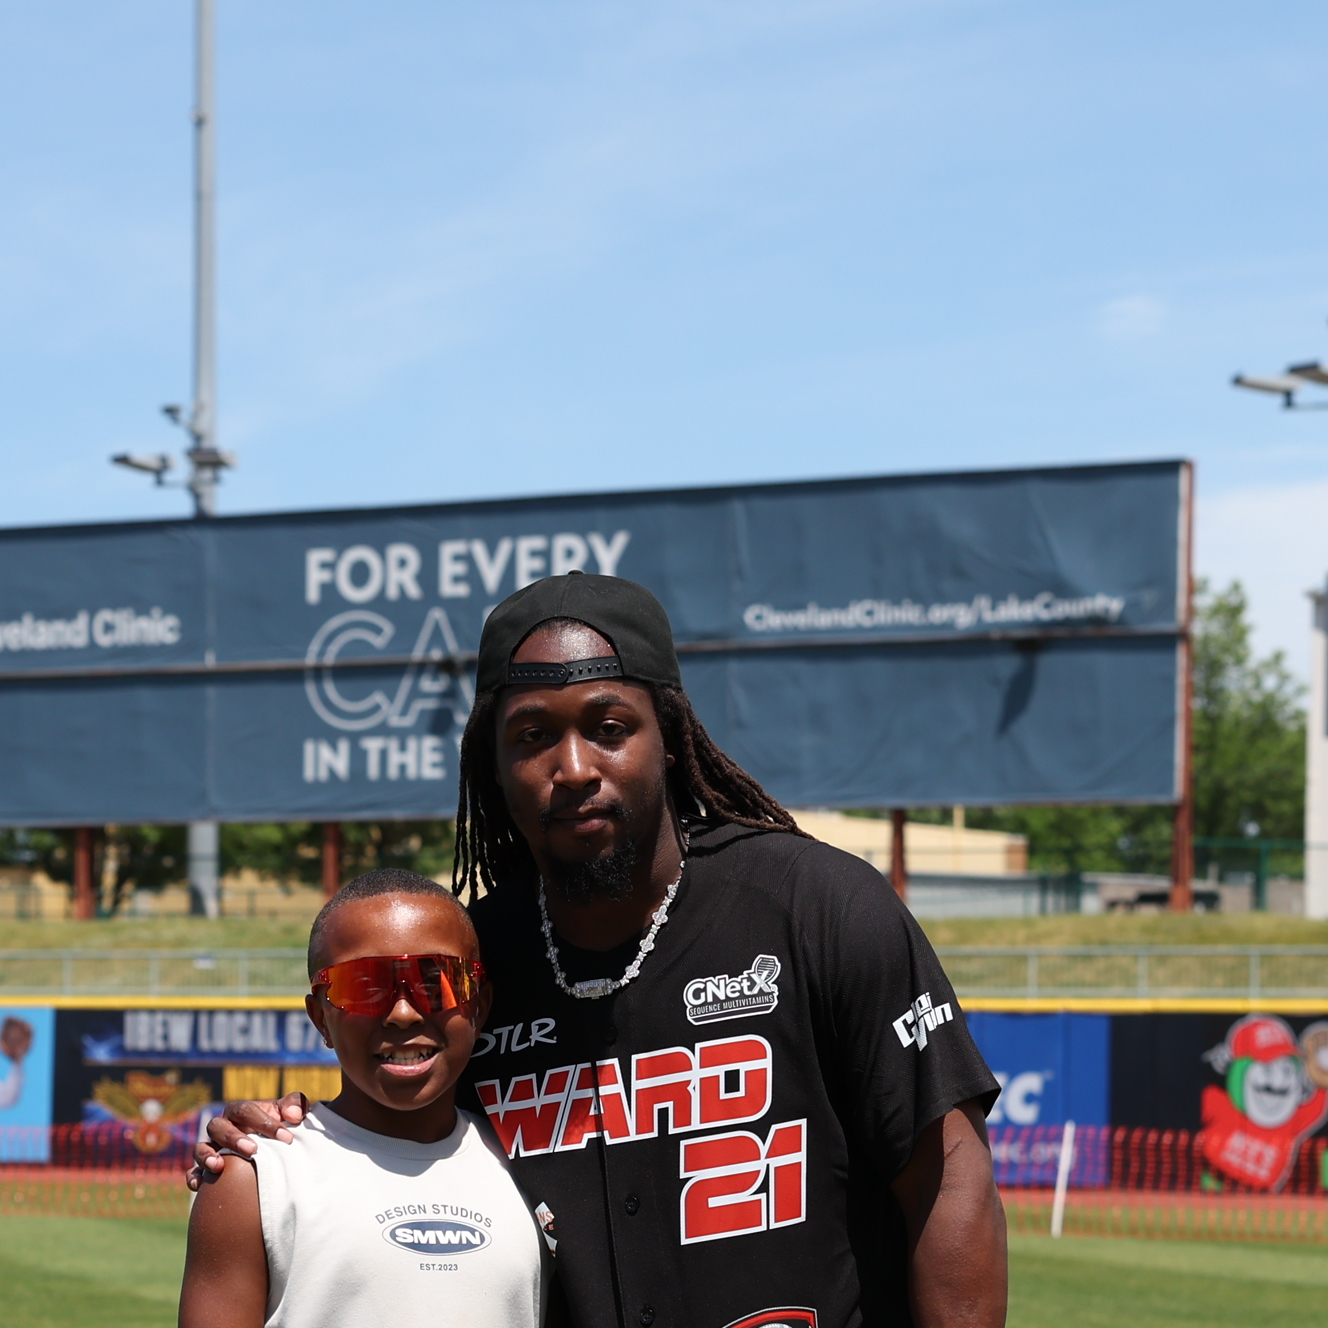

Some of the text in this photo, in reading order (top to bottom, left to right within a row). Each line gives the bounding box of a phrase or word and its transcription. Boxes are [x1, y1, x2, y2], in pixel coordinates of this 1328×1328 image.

[304, 530, 632, 605] FOR EVERY
[92, 606, 183, 648] Clinic
[302, 735, 447, 785] IN THE
[687, 966, 774, 1007] GNetX
[689, 994, 775, 1018] SEQUENCE MULTIVITAMINS
[197, 1009, 280, 1051] LOCAL
[474, 1033, 773, 1159] WARD
[679, 1118, 808, 1246] 21
[374, 1203, 494, 1229] DESIGN STUDIOS
[394, 1227, 482, 1246] SMWN
[419, 1262, 459, 1272] EST.2023
